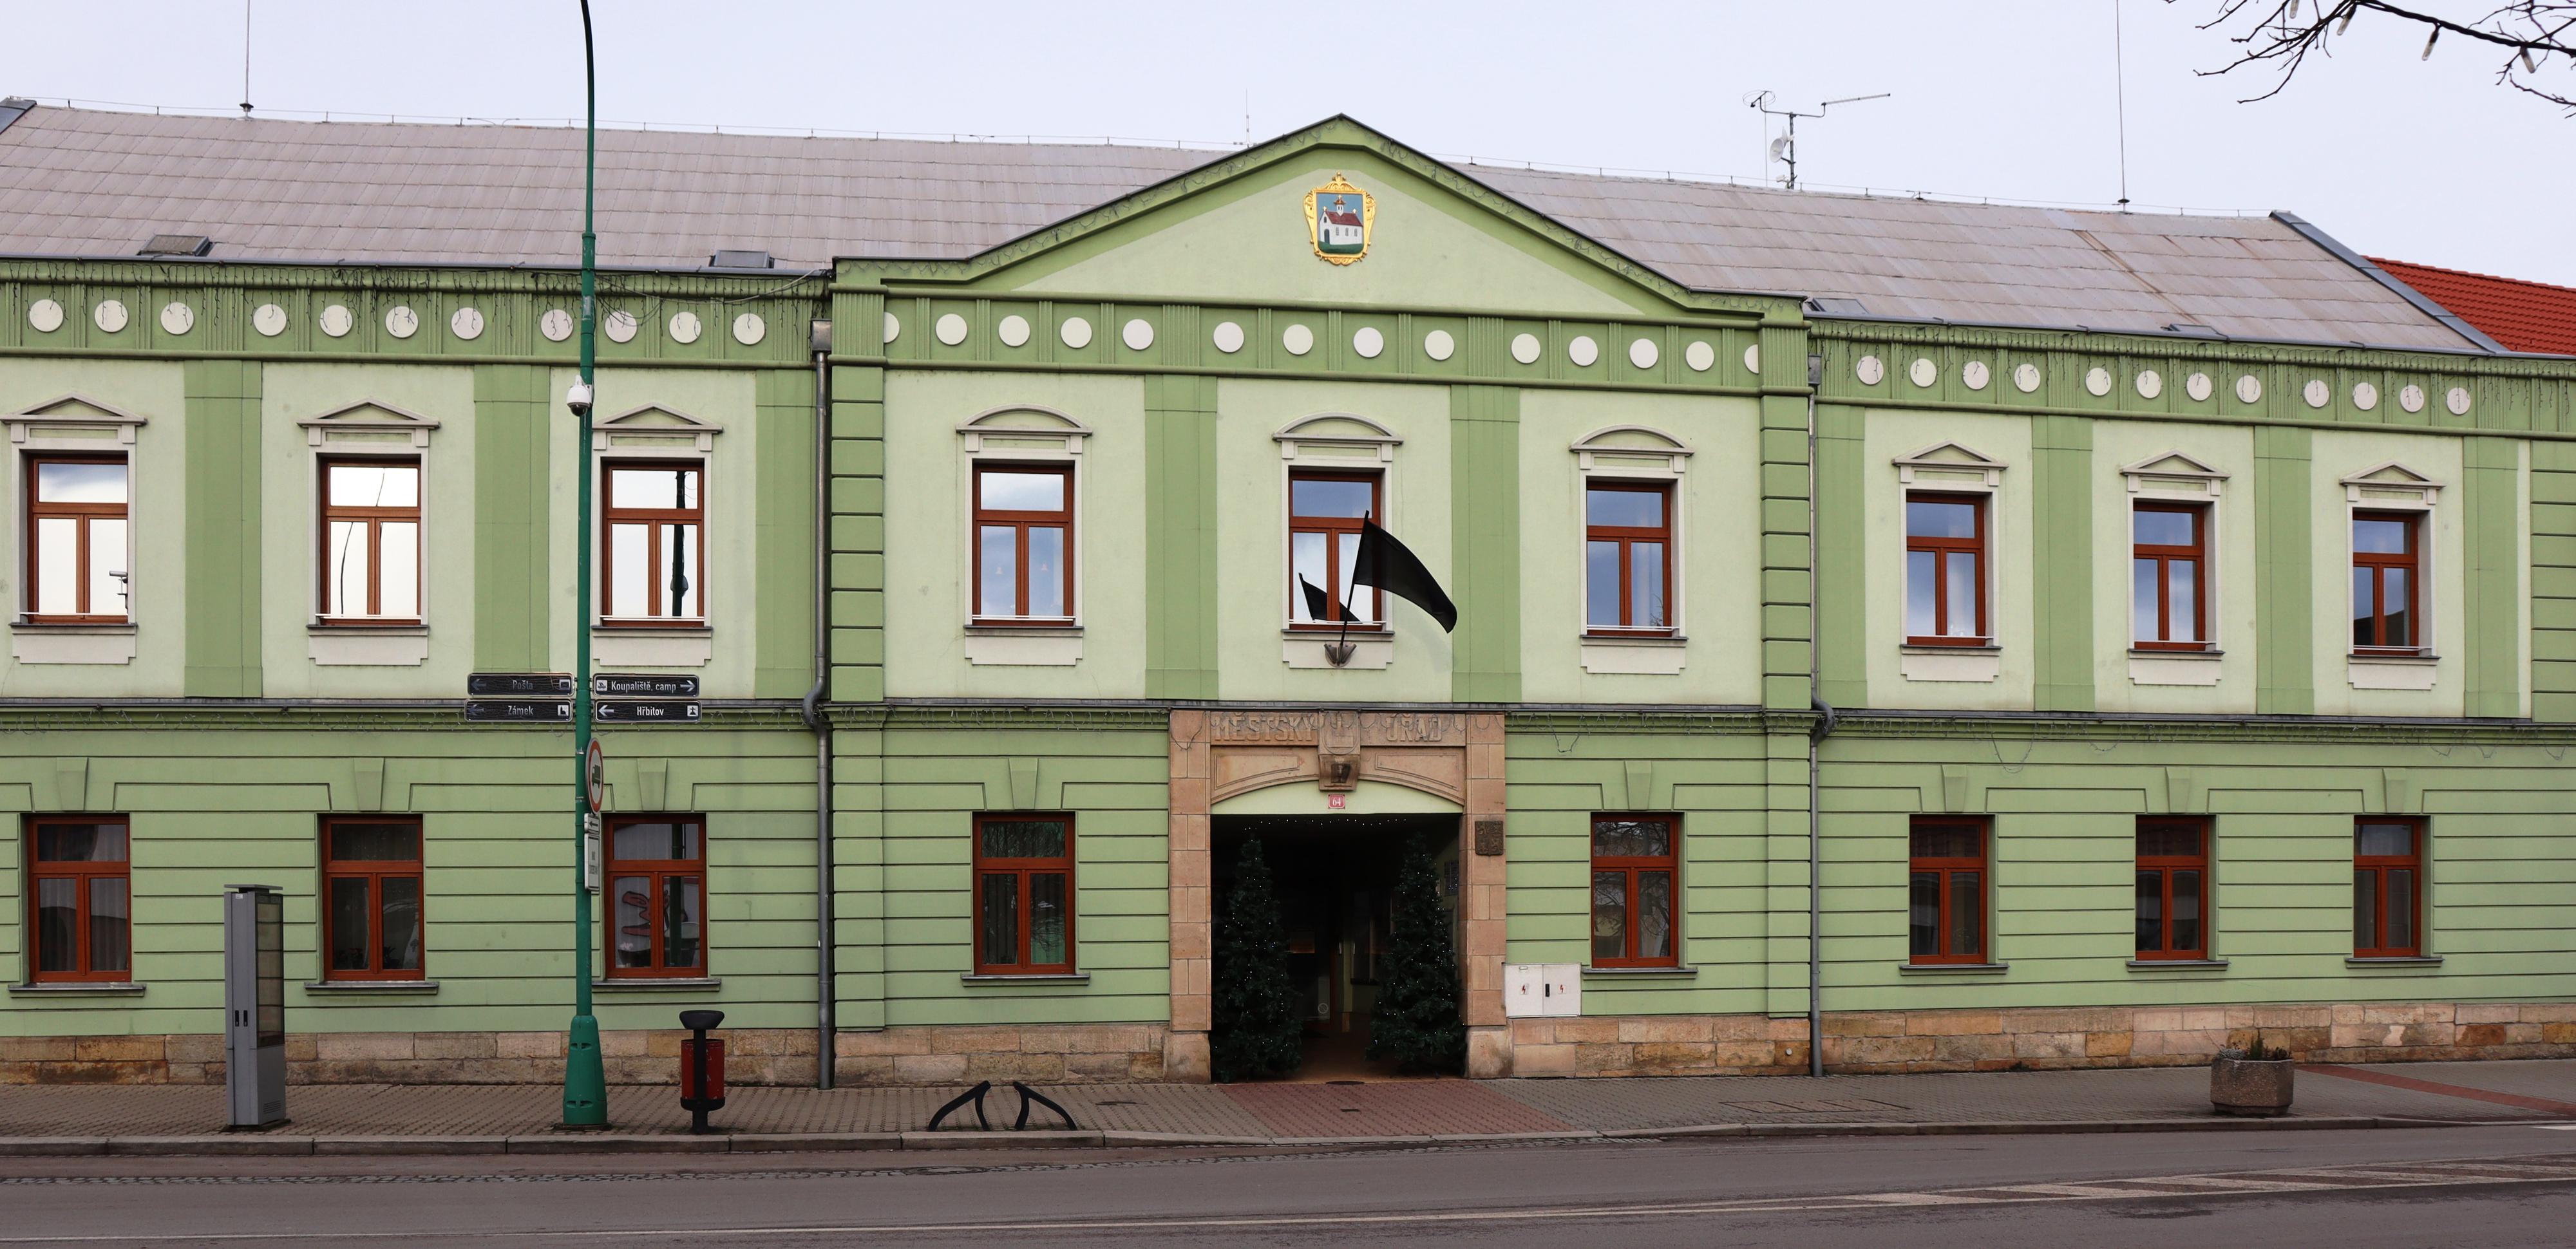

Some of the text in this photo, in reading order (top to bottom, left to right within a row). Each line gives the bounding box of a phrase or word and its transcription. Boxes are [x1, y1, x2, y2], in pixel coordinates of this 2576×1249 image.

[512, 679, 533, 690] Pošta
[611, 681, 676, 693] Koupaliště, camp
[507, 705, 534, 715] Zámek
[636, 706, 665, 716] Hřbitov
[1332, 798, 1341, 806] 64
